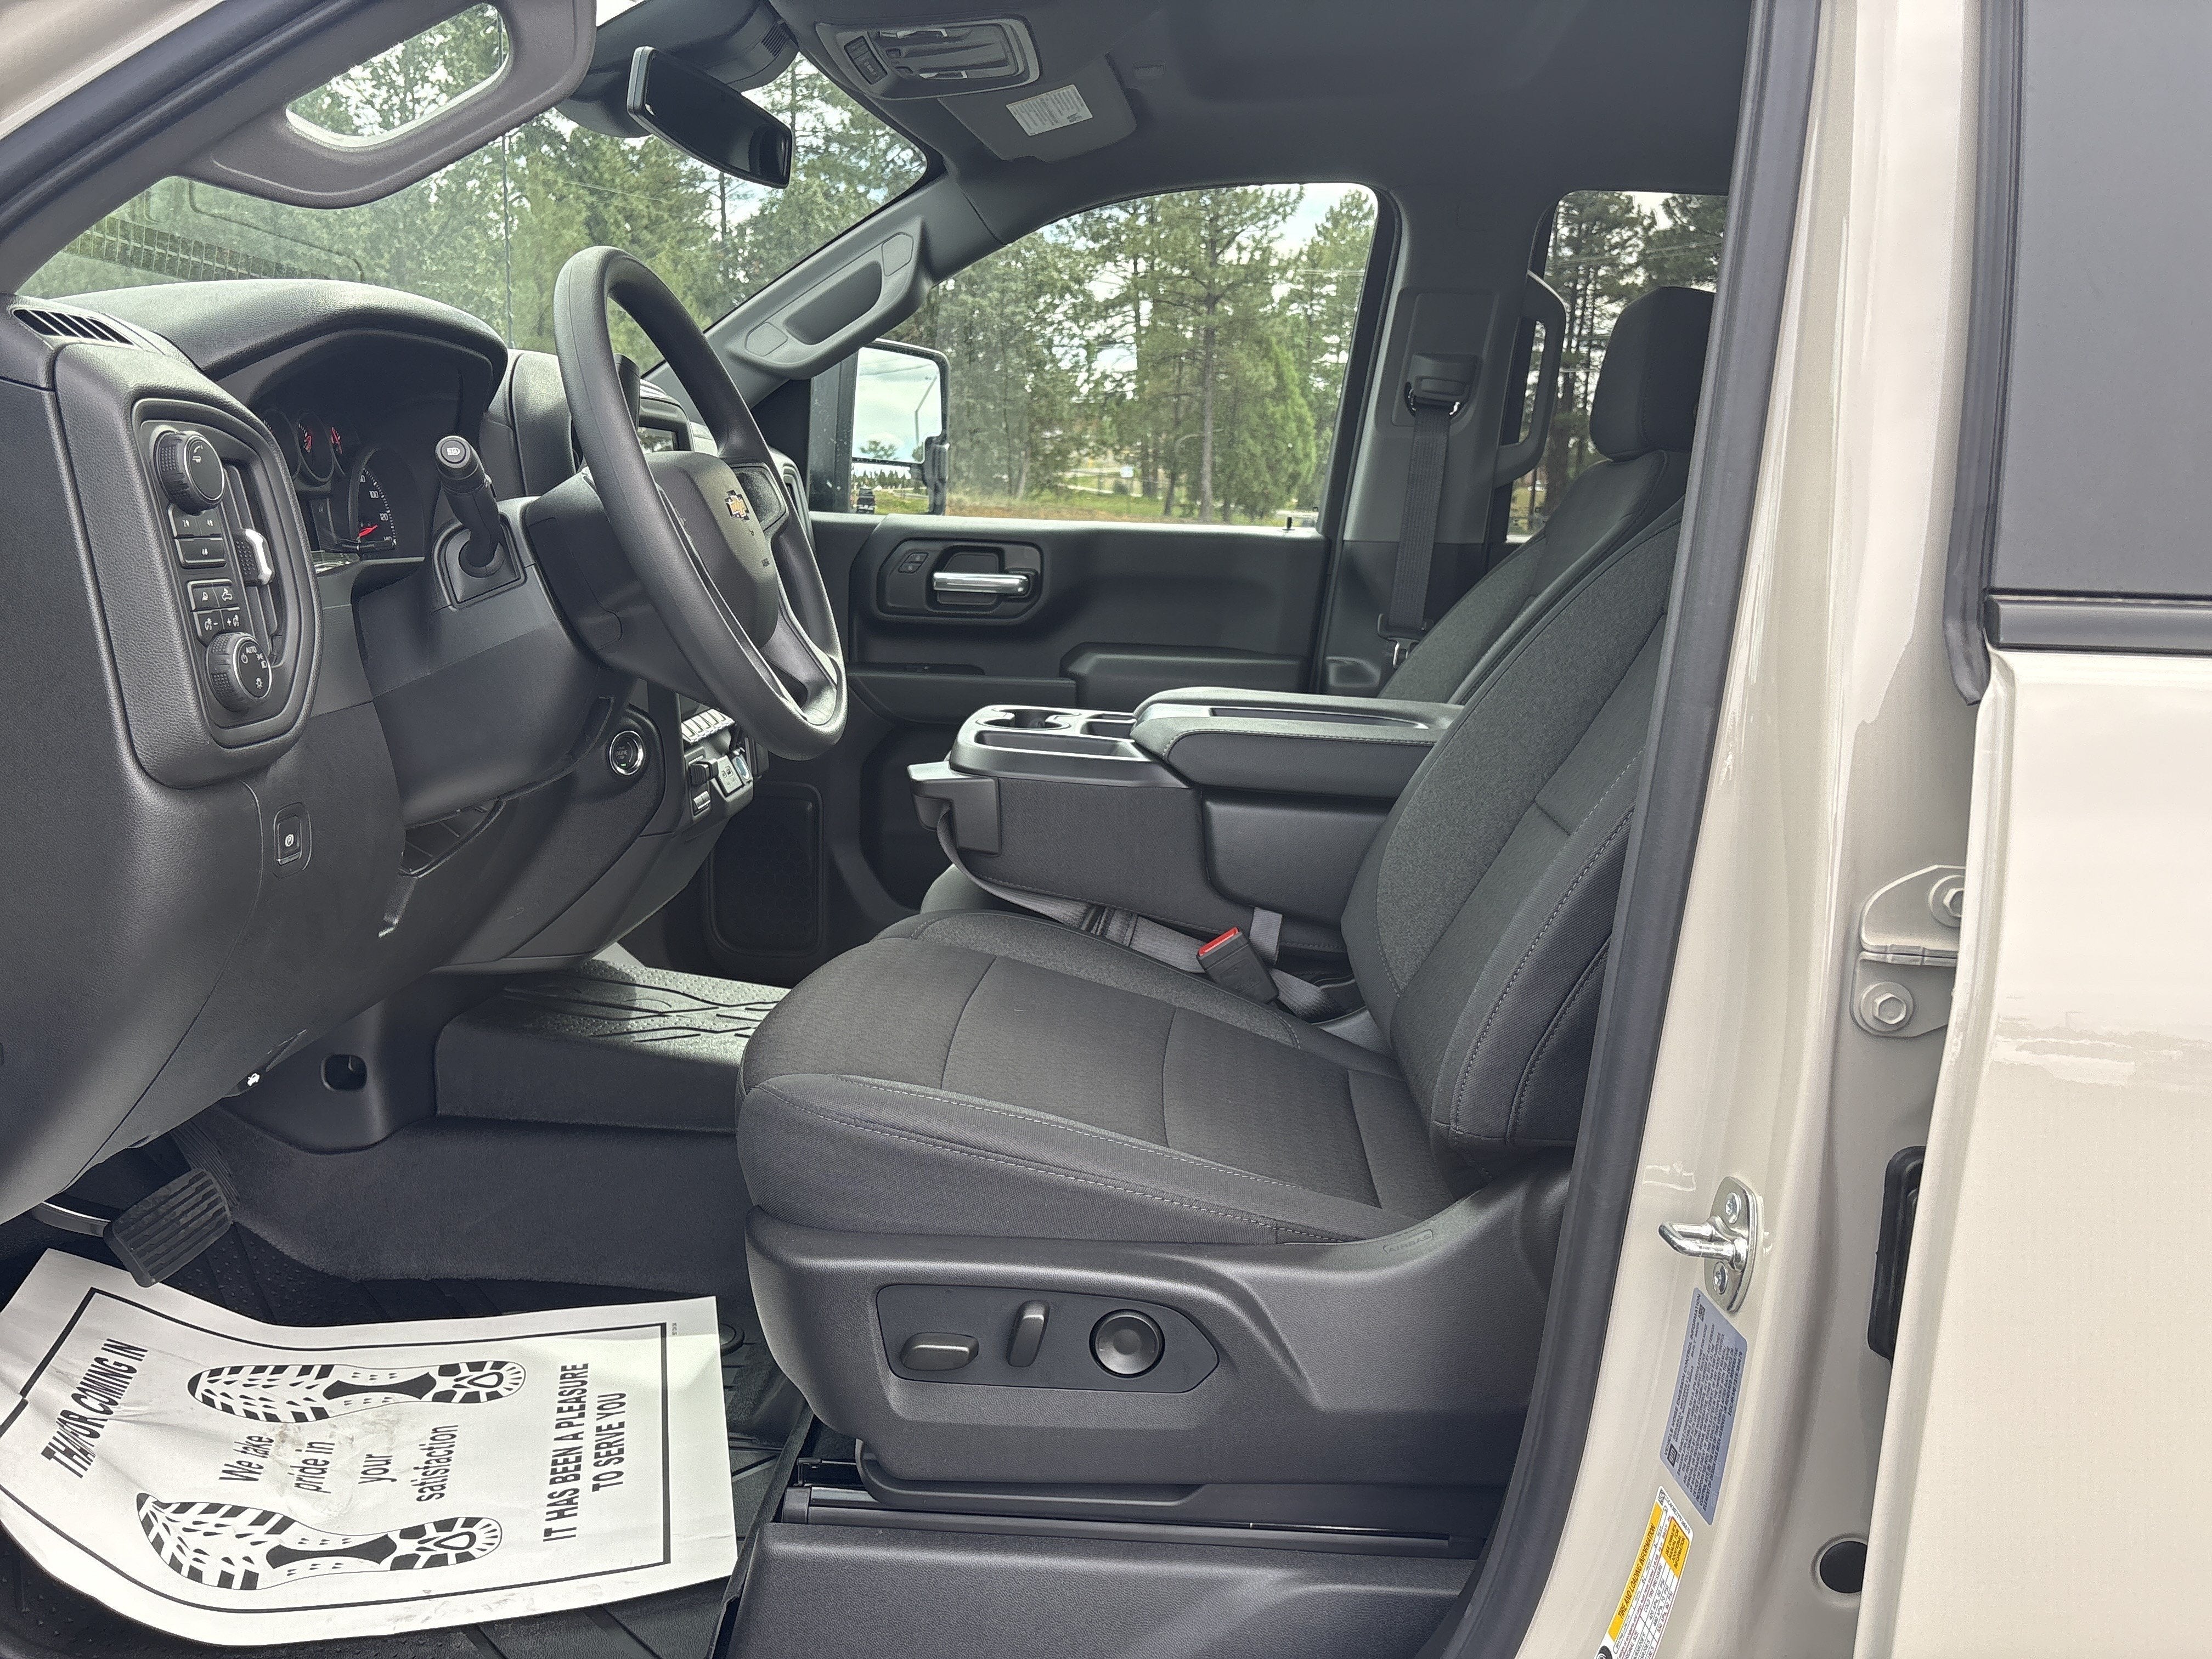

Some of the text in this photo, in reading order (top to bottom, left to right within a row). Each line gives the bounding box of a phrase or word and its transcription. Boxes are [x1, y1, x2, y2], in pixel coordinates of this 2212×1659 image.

[101, 1338, 148, 1362] IN
[1664, 1427, 1673, 1455] VEHICLE
[1676, 1373, 1685, 1406] EMISSION
[1683, 1342, 1692, 1373] CONTROL
[1690, 1294, 1700, 1339] INFORMATION
[71, 1357, 138, 1415] COMING
[219, 1435, 274, 1482] We take
[287, 1441, 335, 1494] pride in
[358, 1453, 398, 1485] your
[410, 1425, 459, 1502] satisfaction
[543, 1363, 589, 1542] IT HAS BEEN A PLEASURE
[591, 1392, 627, 1492] TO SERVE YOU
[1617, 1602, 1627, 1619] TIRE
[1629, 1563, 1641, 1593] LOADING
[1639, 1523, 1655, 1565] INFORMATION
